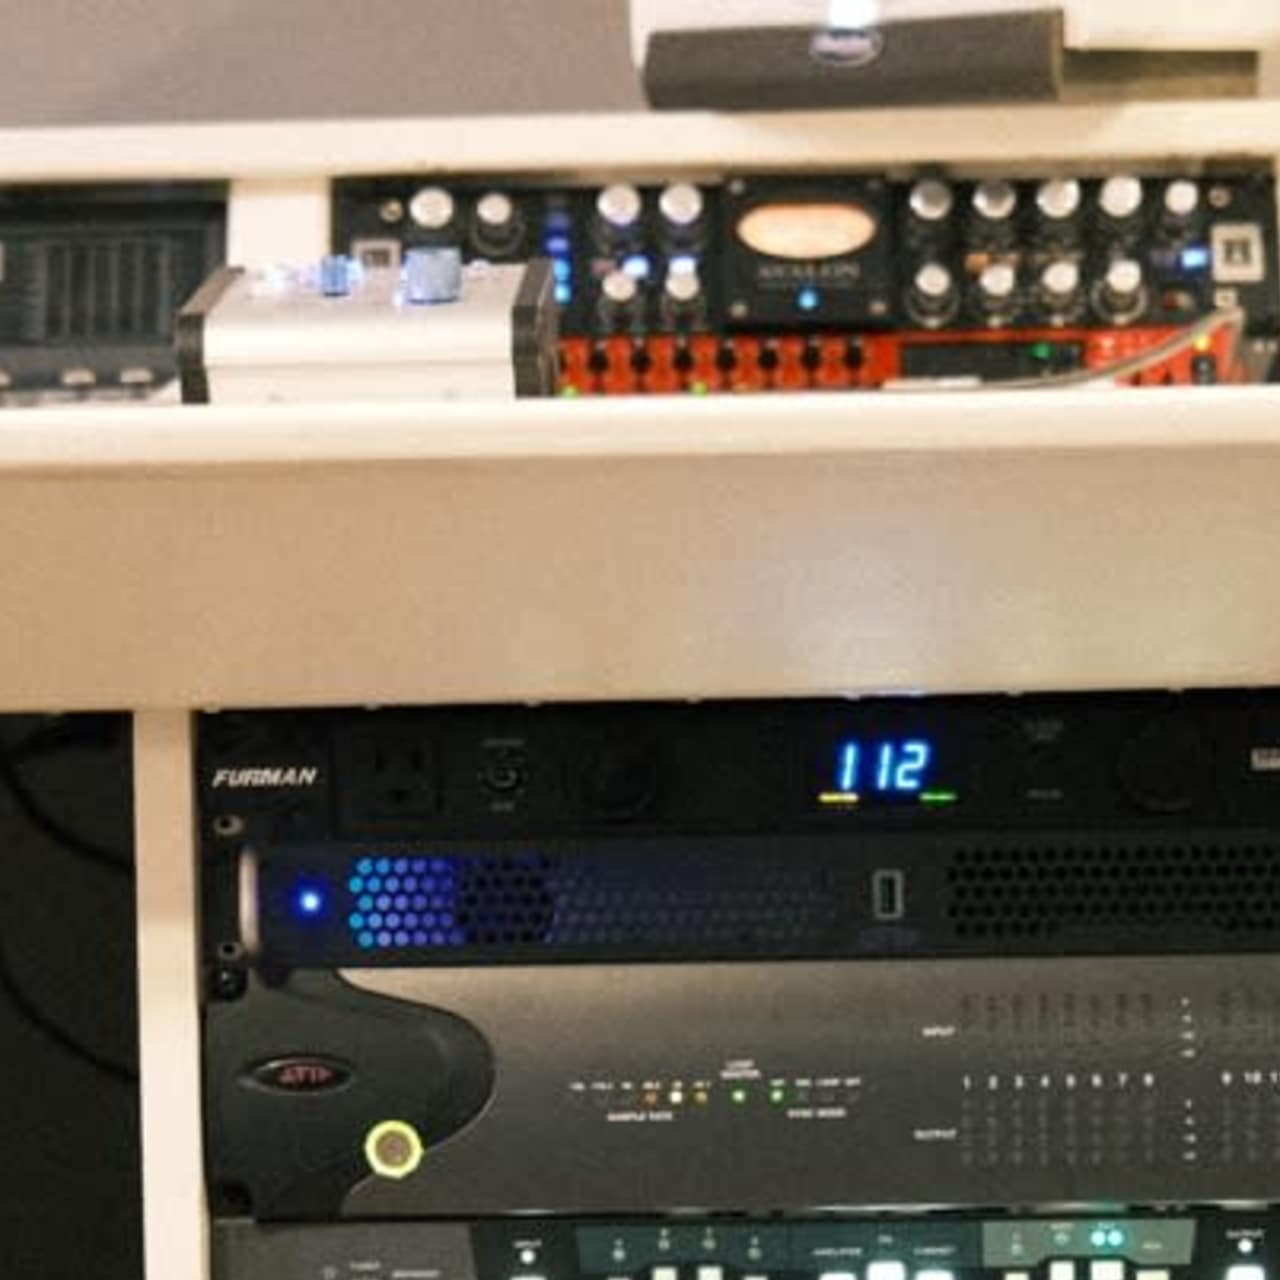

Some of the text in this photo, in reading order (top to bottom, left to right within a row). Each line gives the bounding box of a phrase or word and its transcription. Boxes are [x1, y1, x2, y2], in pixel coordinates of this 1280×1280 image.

[211, 766, 318, 789] FURMAN
[840, 742, 928, 790] 112
[963, 1075, 971, 1090] 1
[988, 1075, 999, 1090] 2
[1118, 1072, 1128, 1087] 7
